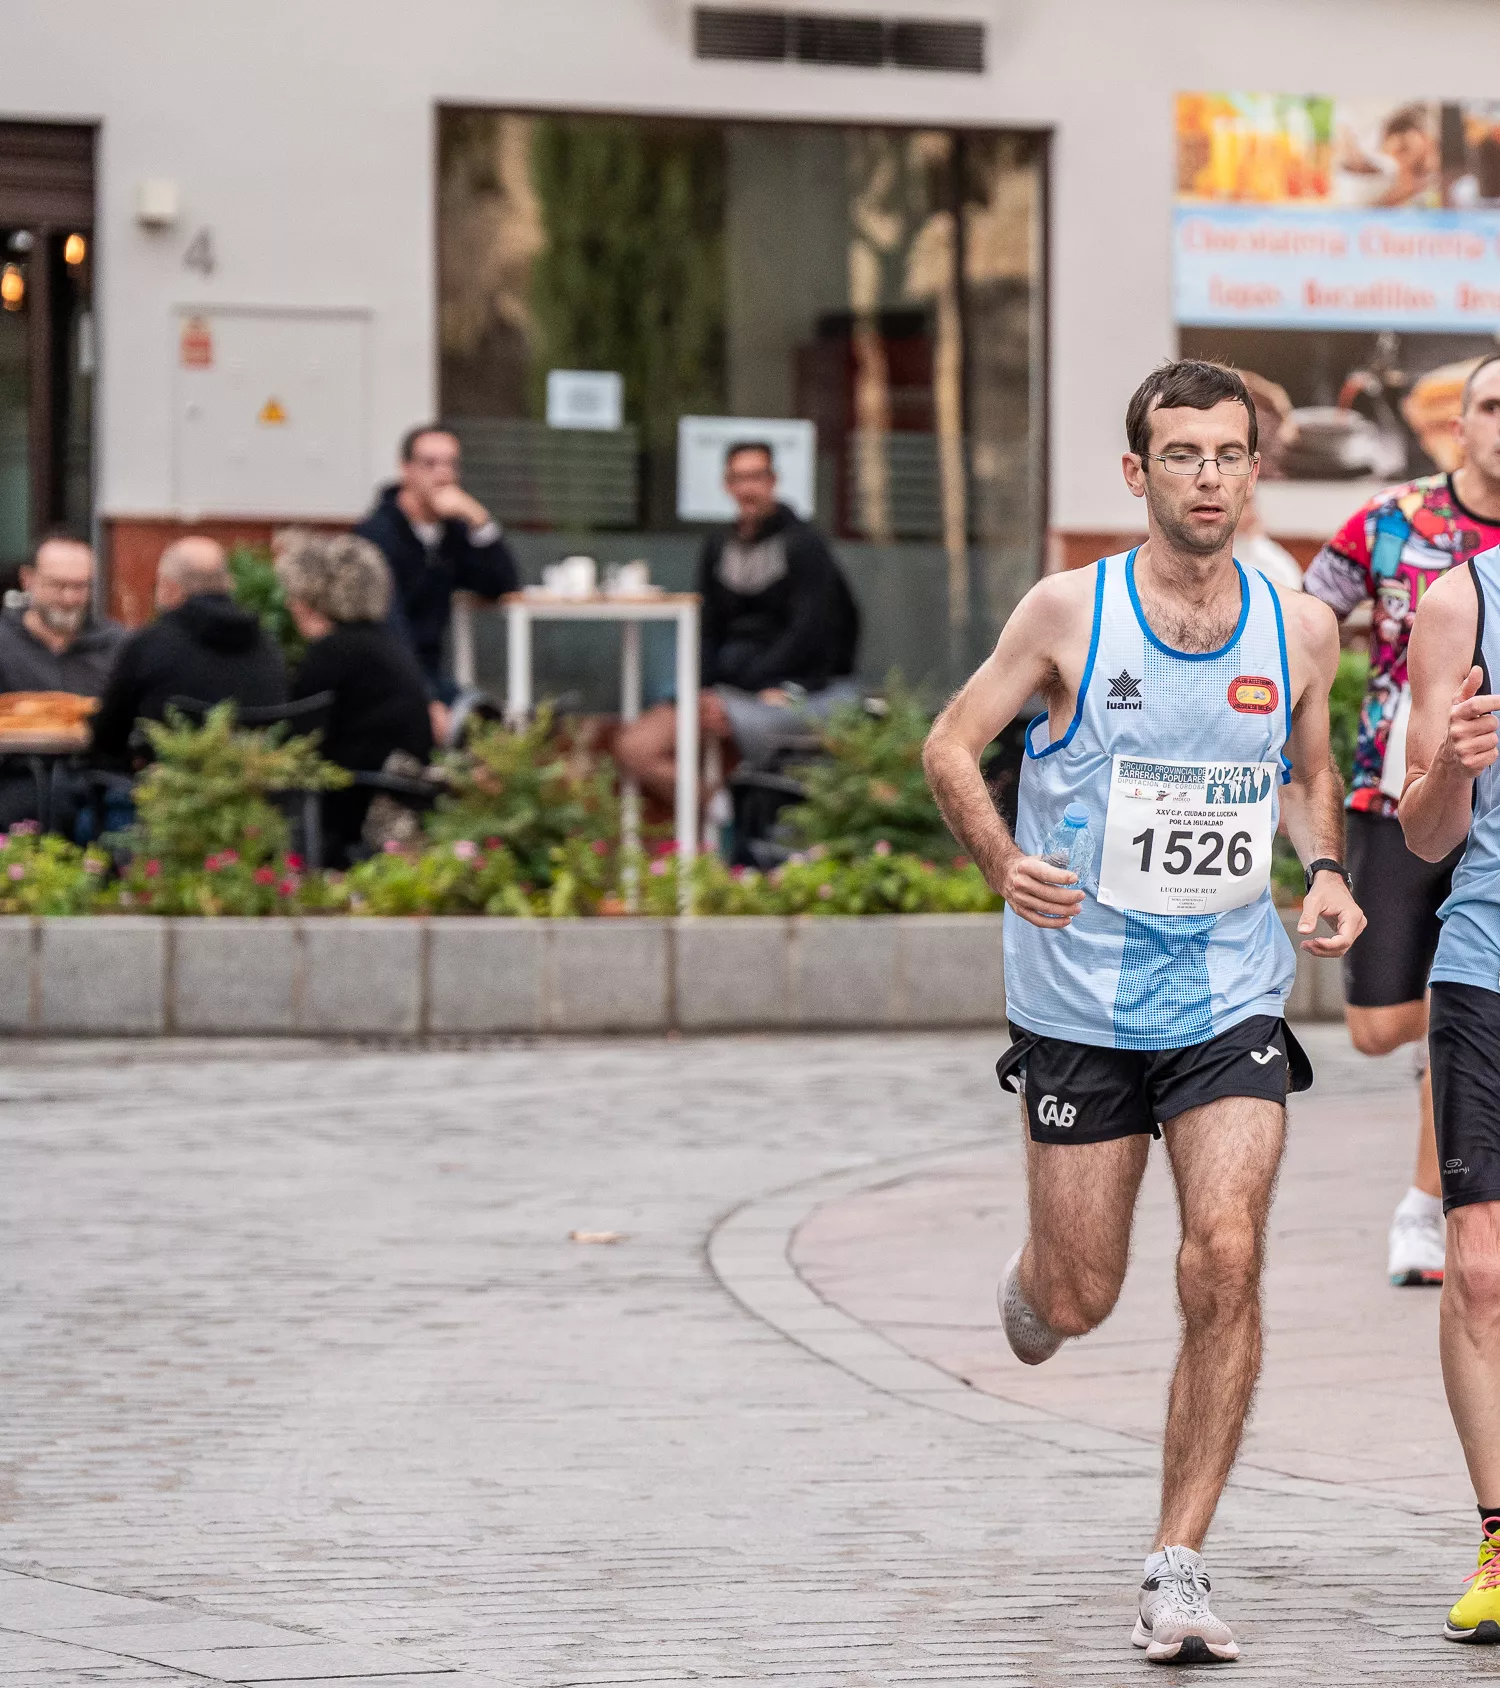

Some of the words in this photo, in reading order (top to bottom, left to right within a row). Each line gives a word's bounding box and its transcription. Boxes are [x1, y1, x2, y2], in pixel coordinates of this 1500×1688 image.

[183, 225, 216, 279] 4
[1106, 700, 1142, 710] luanvi
[1119, 769, 1160, 780] CARRERAS
[1163, 774, 1206, 784] POPULARES
[1120, 762, 1152, 772] CIRCUITO
[1155, 766, 1196, 776] PROVINCIAL
[1198, 768, 1206, 776] DE
[1206, 766, 1244, 785] 2024
[1132, 828, 1253, 877] 1526
[1037, 1094, 1077, 1128] CAB
